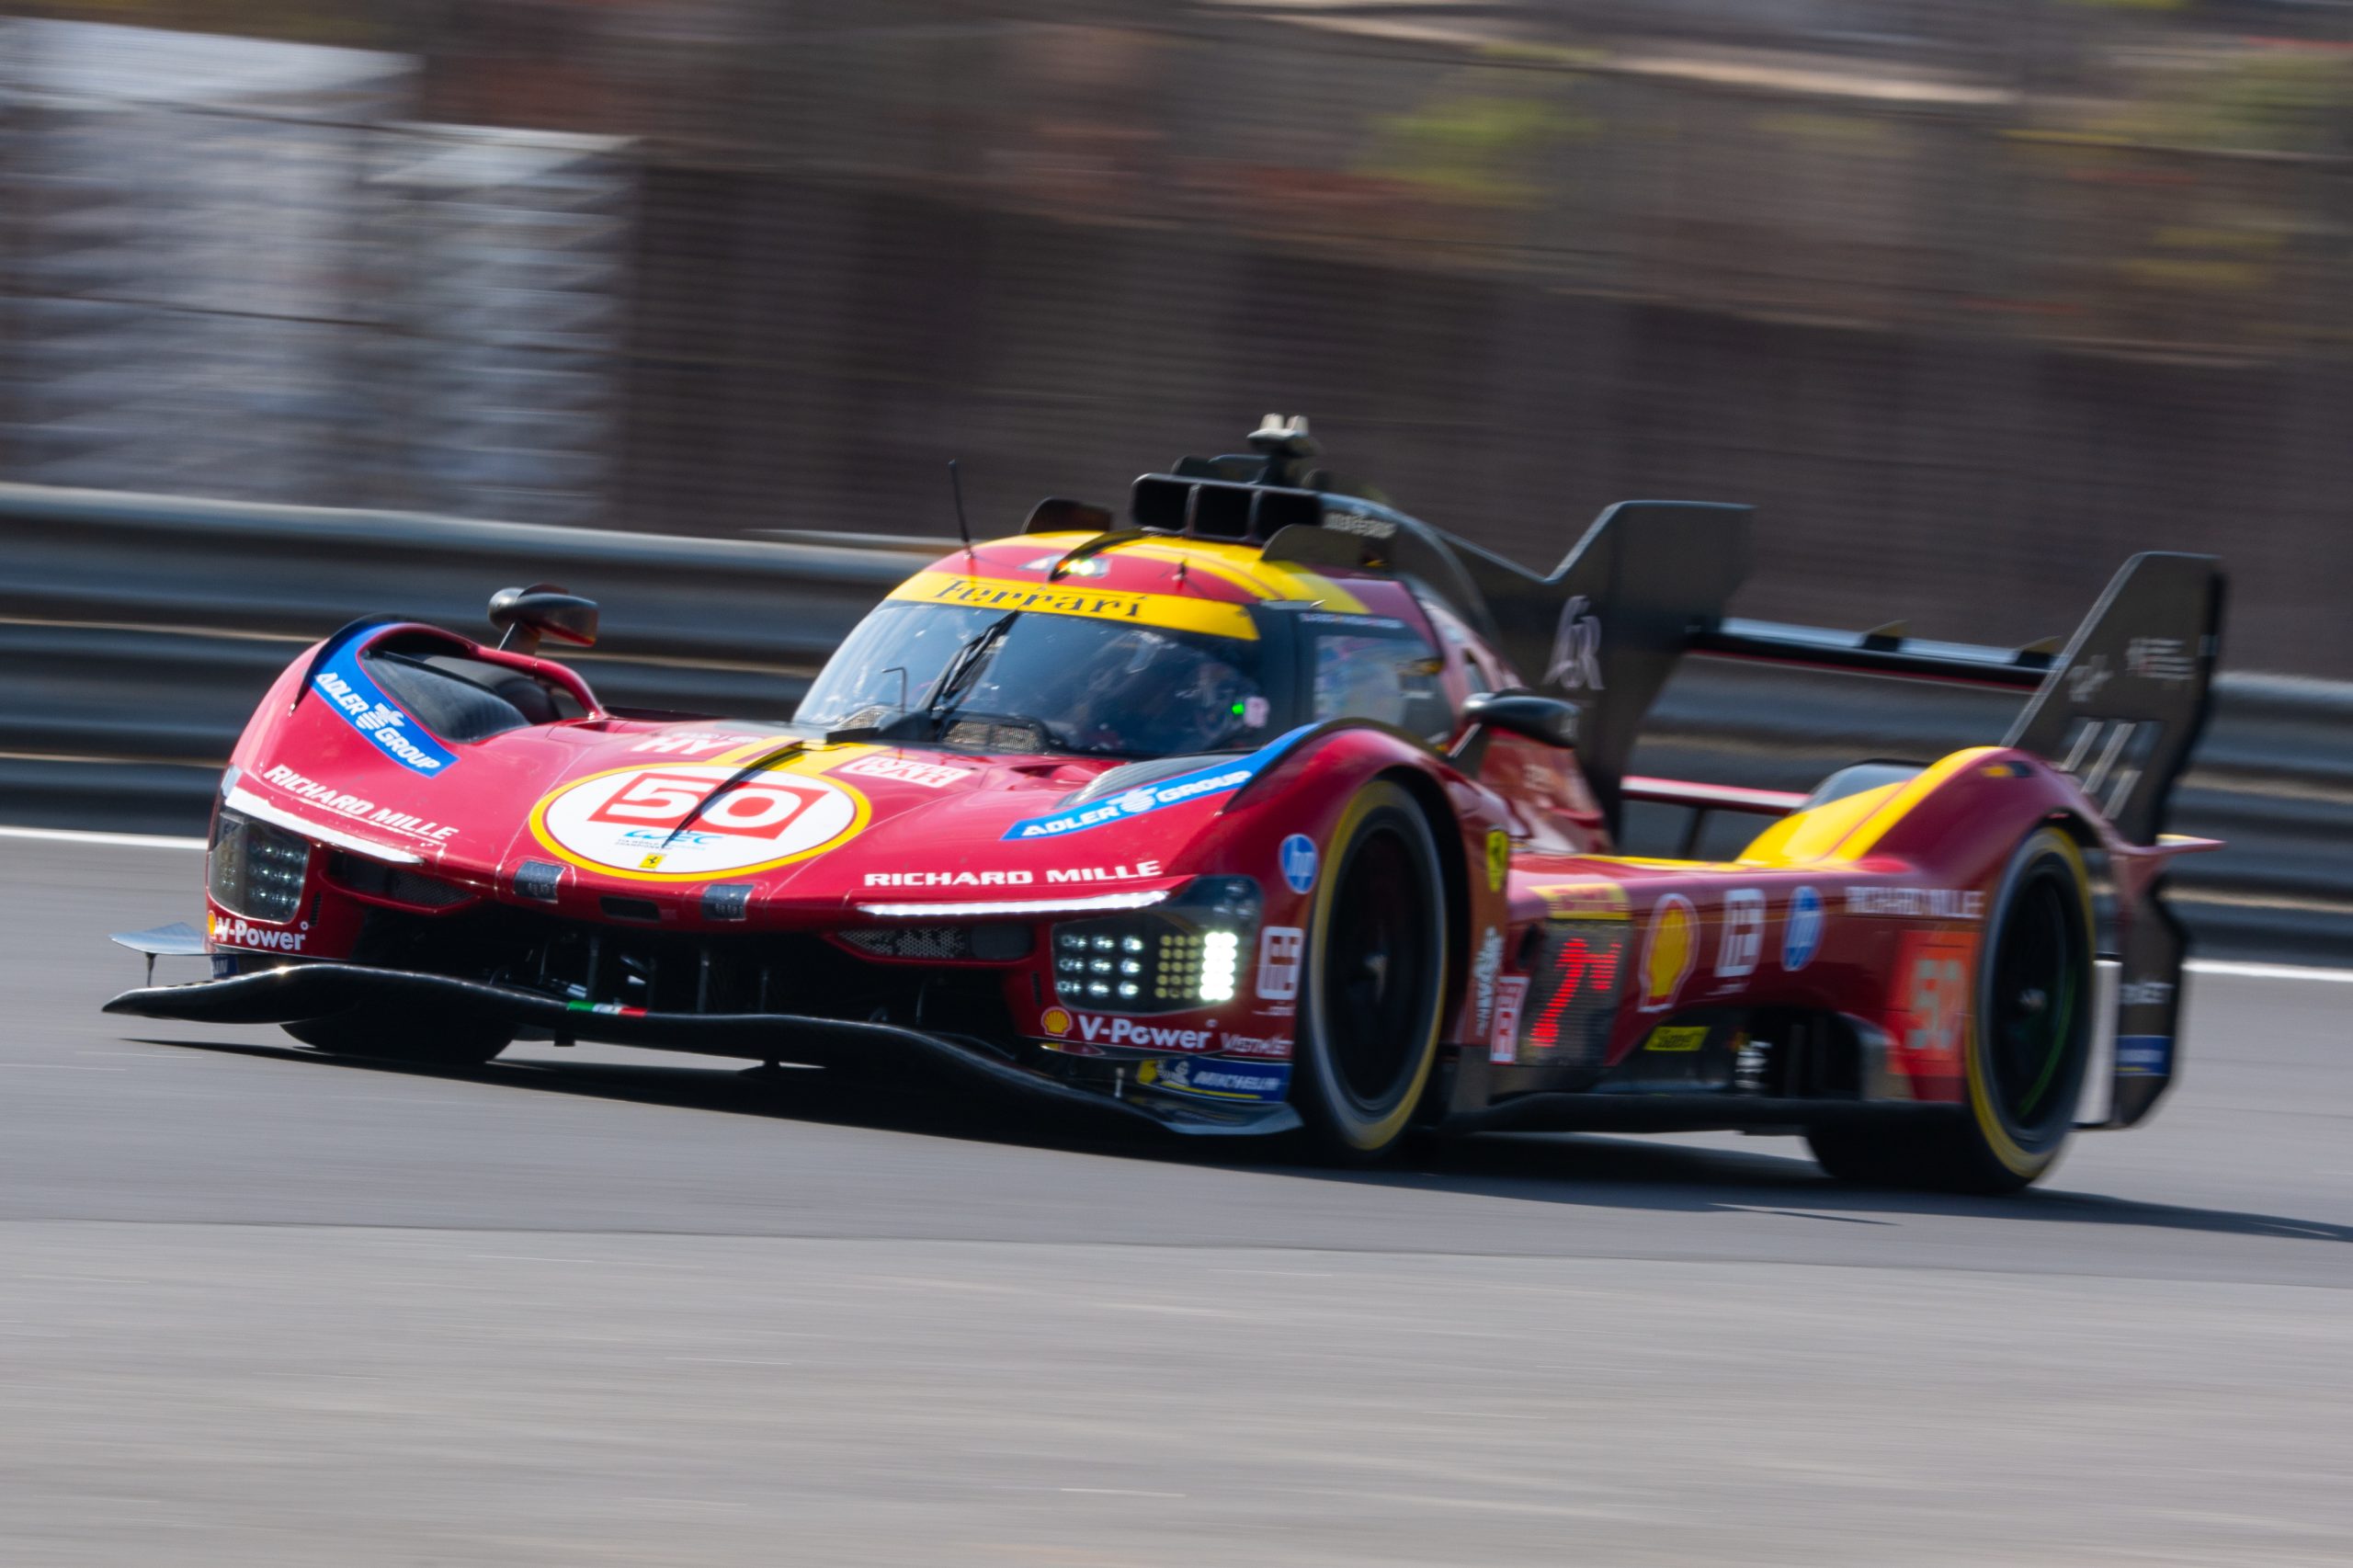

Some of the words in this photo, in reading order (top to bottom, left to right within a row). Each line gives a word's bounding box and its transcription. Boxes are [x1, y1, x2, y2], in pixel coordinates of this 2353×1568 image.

[936, 578, 1146, 618] Ferrari
[314, 673, 369, 715] ADLER
[374, 727, 441, 768] GROUP
[852, 764, 946, 783] CAR
[263, 764, 374, 815] RICHARD
[369, 808, 459, 840] MILLE
[606, 778, 802, 828] 50
[1021, 805, 1120, 836] ADLER
[1155, 770, 1253, 803] GROUP
[864, 870, 1033, 886] RICHARD
[1046, 860, 1164, 883] MILLE
[216, 917, 306, 950] V-Power
[1078, 1015, 1213, 1049] V-Power
